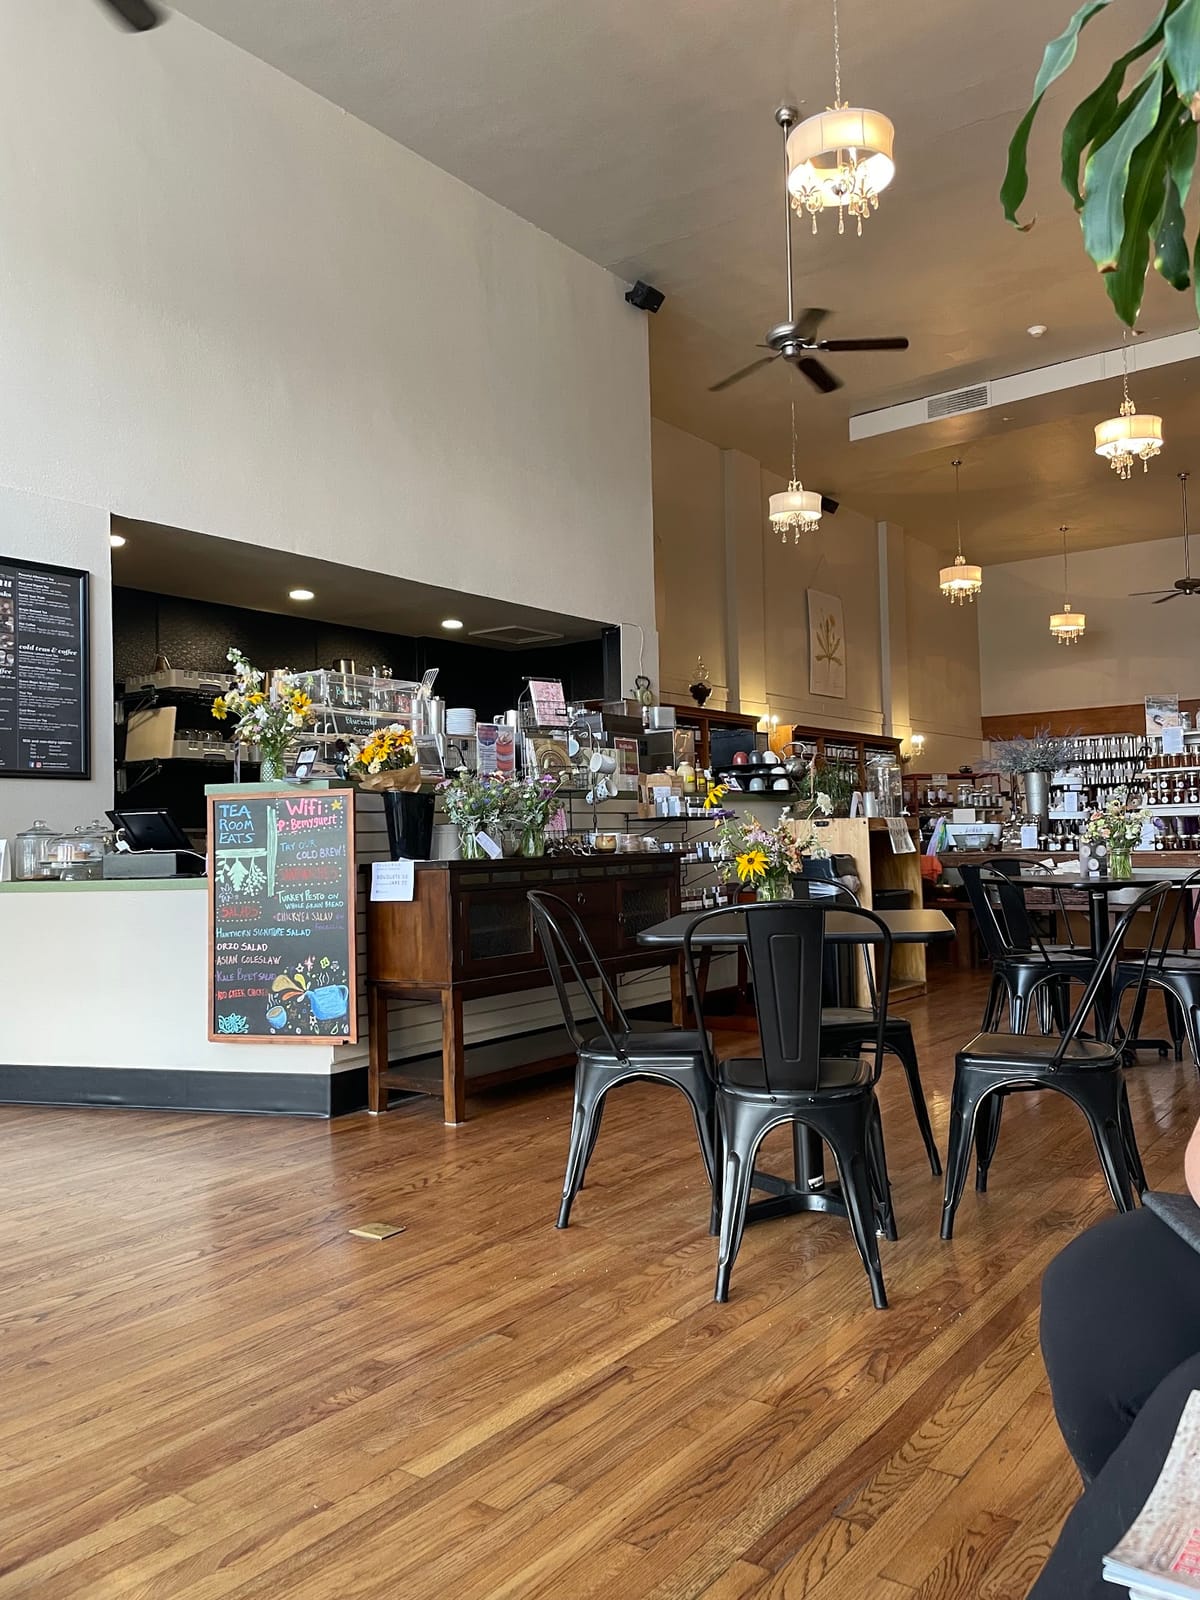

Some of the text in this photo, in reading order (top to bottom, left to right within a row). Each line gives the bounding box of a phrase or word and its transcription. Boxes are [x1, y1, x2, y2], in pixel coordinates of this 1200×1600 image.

[57, 648, 78, 656] coffee
[218, 804, 252, 819] TEA
[219, 818, 254, 832] ROOM
[219, 832, 256, 844] EATS
[296, 849, 318, 860] COLD
[304, 888, 325, 901] PESTO
[285, 928, 312, 937] SALAD
[216, 942, 268, 951] ORZO SALAD
[216, 954, 282, 966] ASIAN COLESLAW
